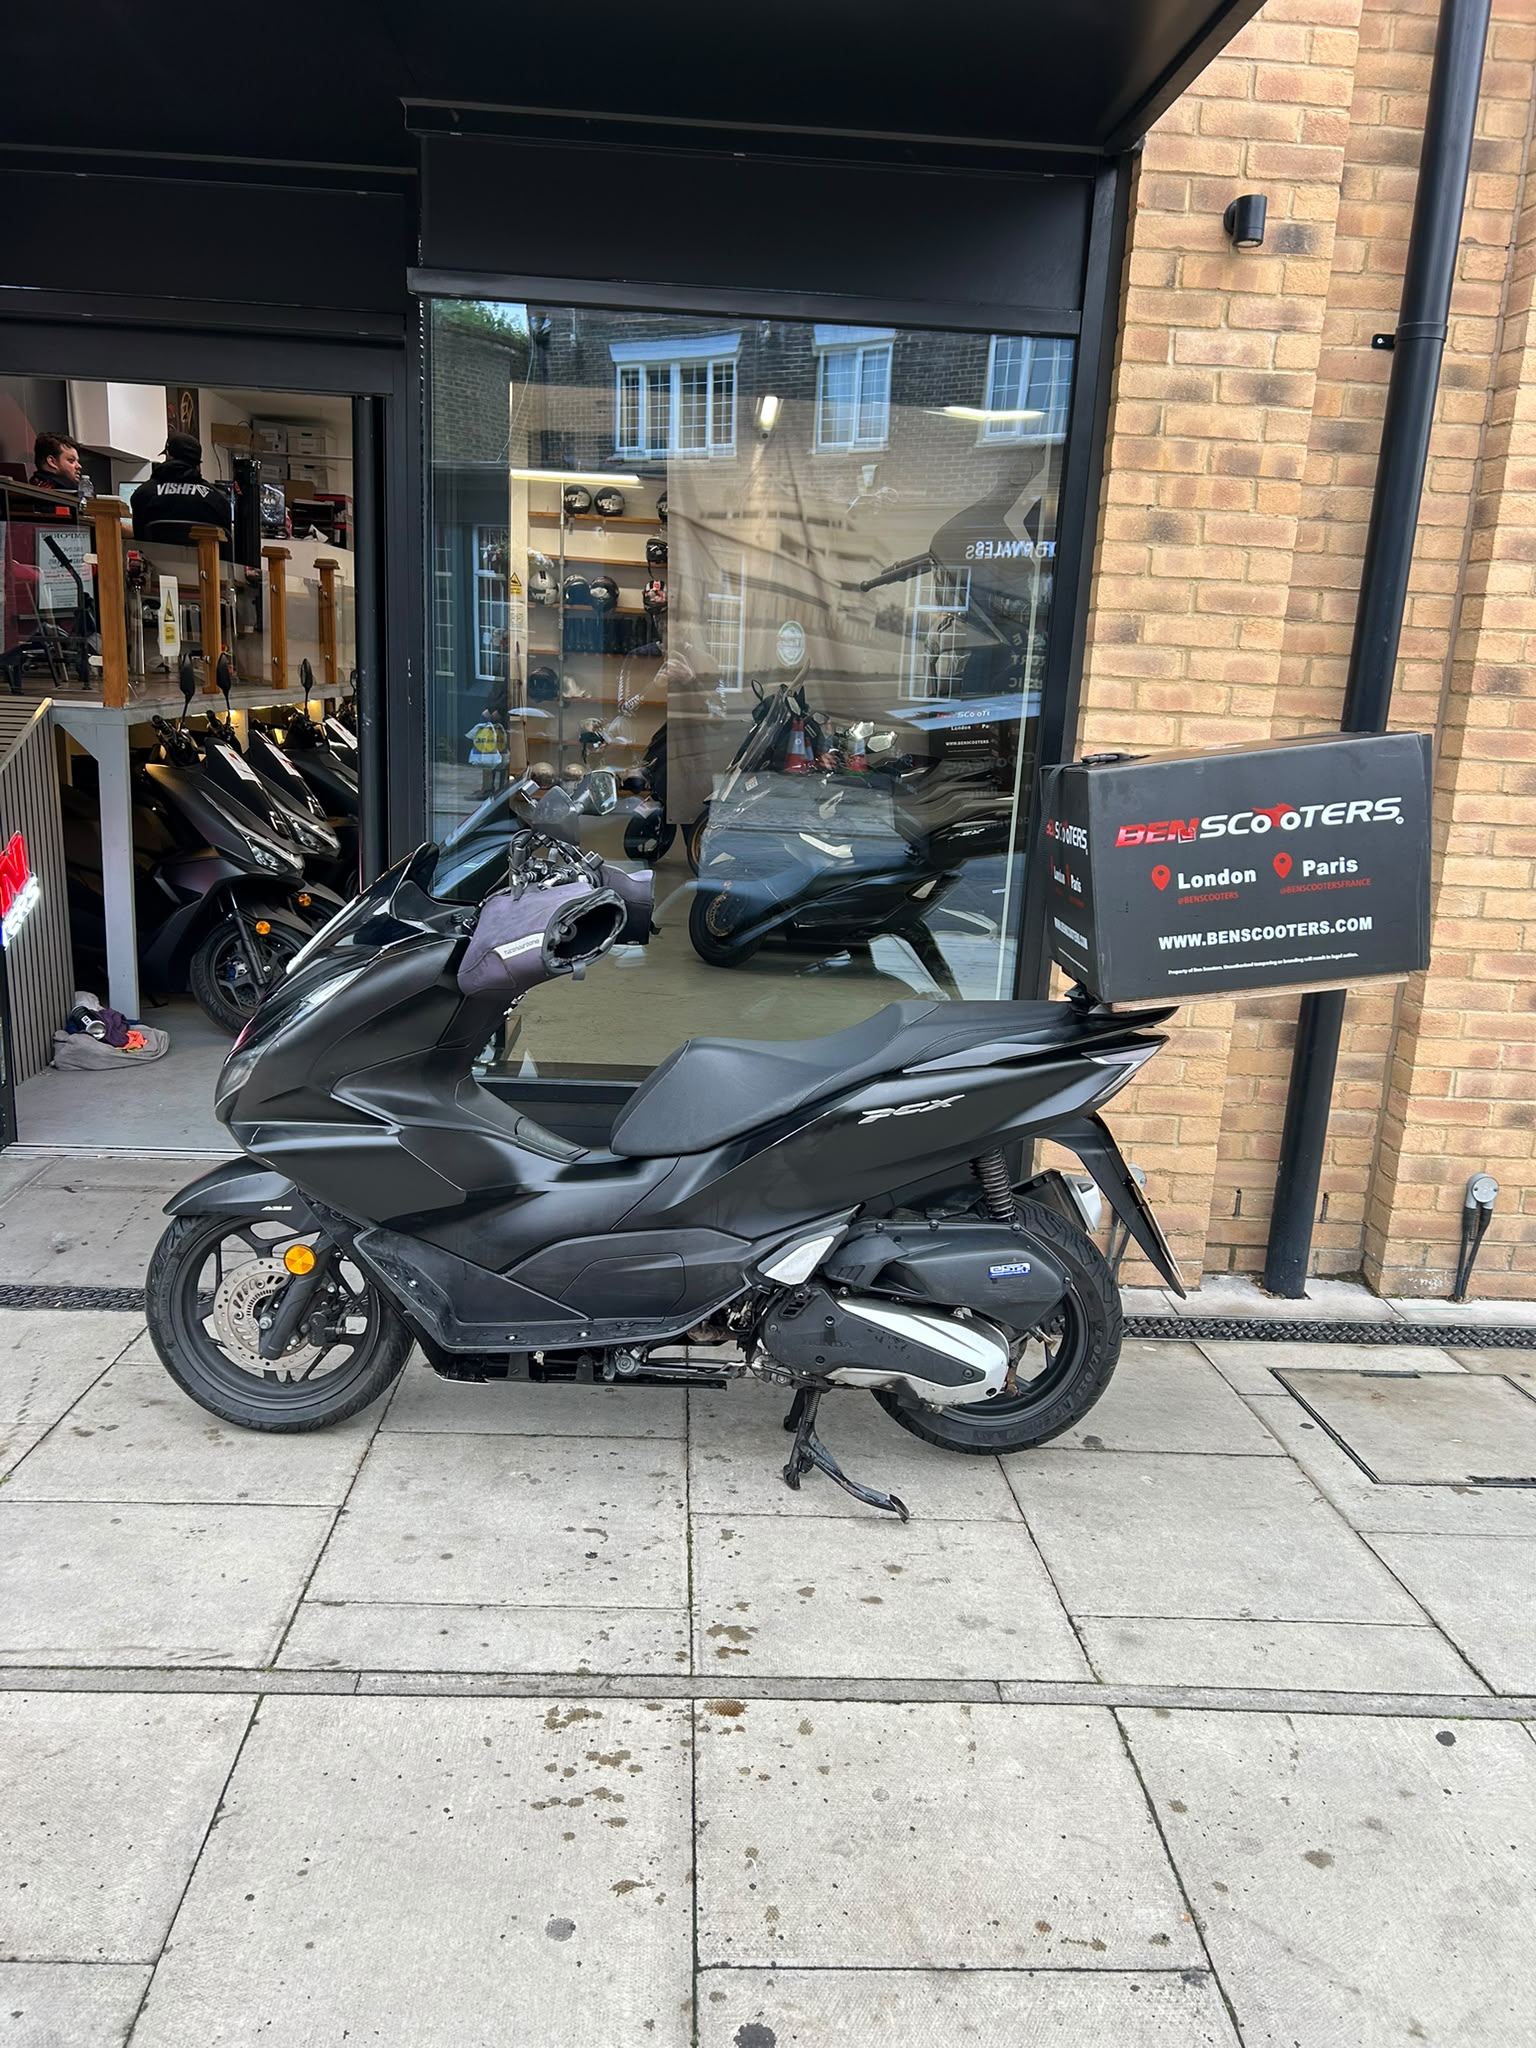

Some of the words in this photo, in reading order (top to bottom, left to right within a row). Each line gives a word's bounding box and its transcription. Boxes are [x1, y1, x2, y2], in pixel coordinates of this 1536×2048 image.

[1115, 797, 1403, 848] BENSCOOTERS
[1177, 868, 1257, 890] London
[1302, 857, 1358, 877] Paris
[1158, 916, 1373, 950] WWW.BENSCOOTERS.COM
[857, 1094, 966, 1125] PCX
